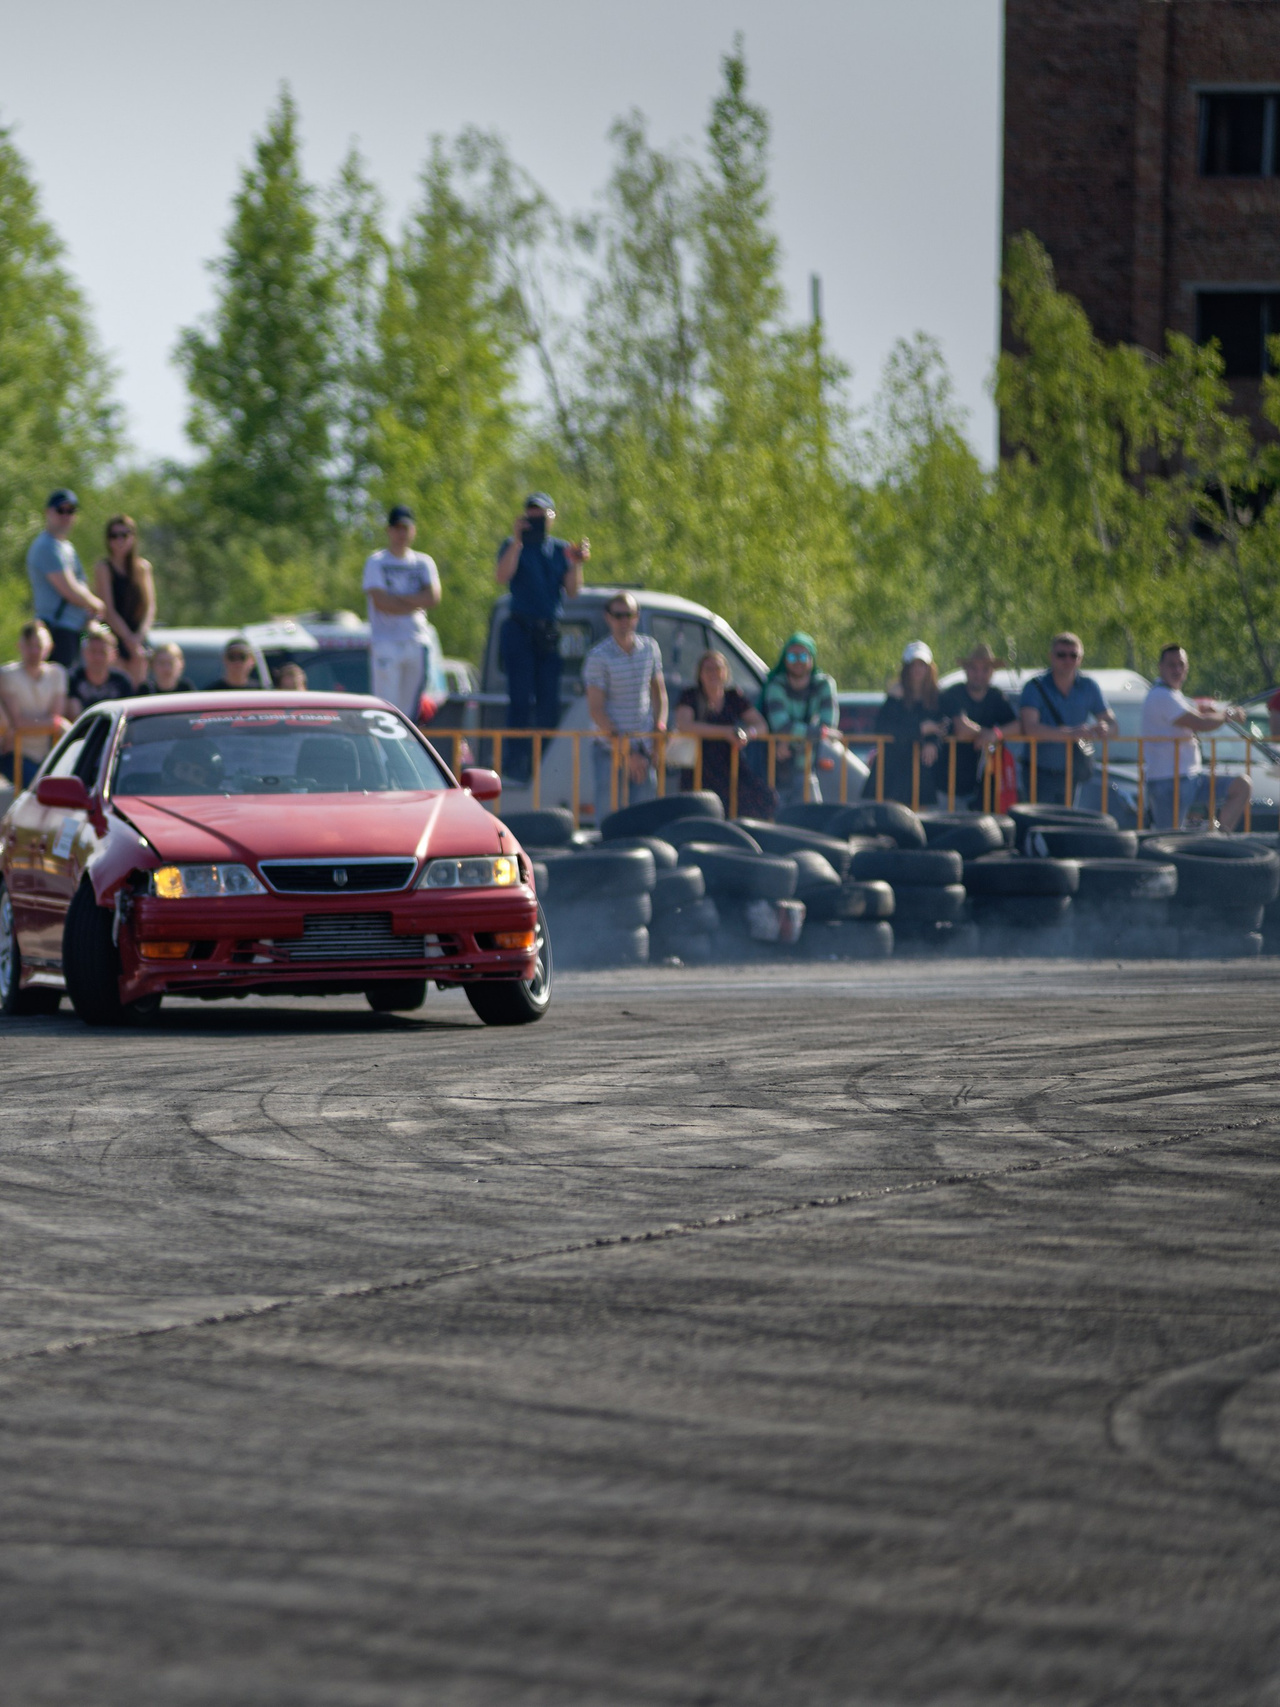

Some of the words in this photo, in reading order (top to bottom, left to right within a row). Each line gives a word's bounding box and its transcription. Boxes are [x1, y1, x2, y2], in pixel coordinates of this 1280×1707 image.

[189, 715, 256, 725] FORMULA
[298, 714, 343, 722] OMSK
[361, 709, 408, 740] 3
